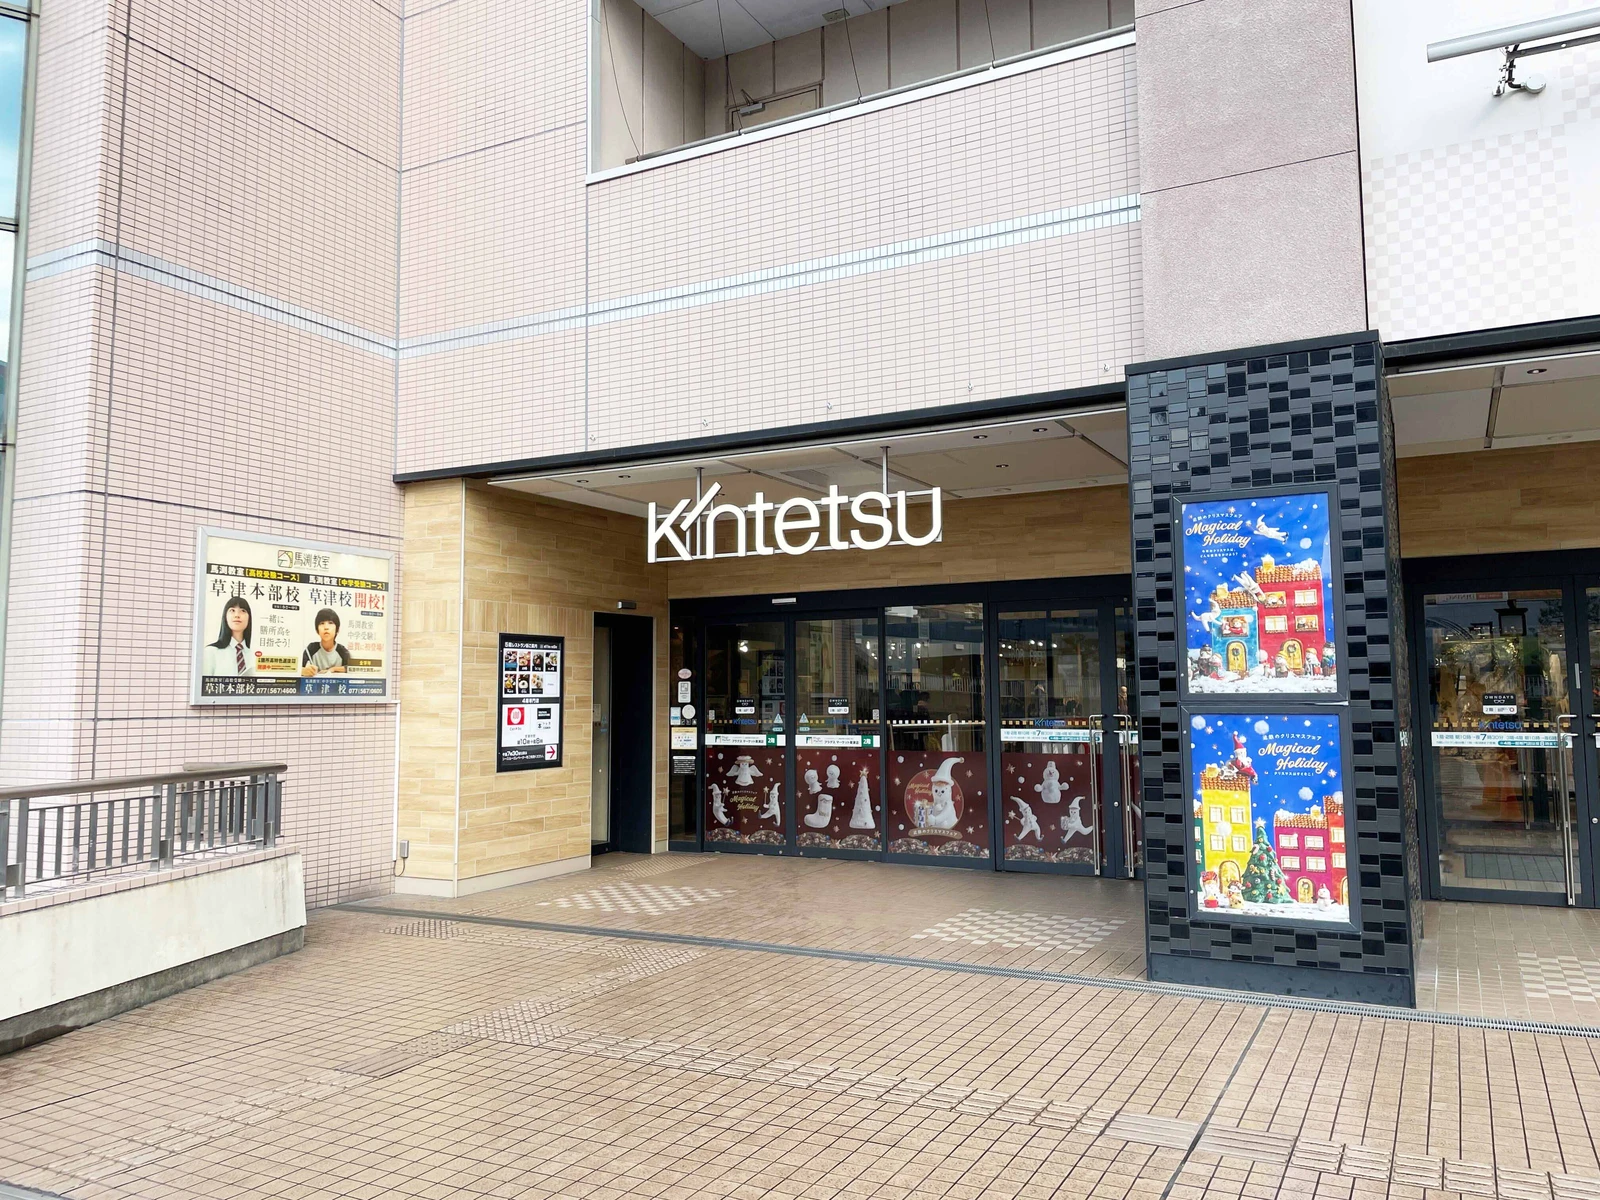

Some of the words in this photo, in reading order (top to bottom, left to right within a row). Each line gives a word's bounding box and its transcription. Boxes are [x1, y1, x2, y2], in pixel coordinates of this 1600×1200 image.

[648, 482, 942, 564] Kintetsu
[1185, 521, 1243, 536] Magical
[1202, 533, 1251, 549] Holiday
[210, 579, 299, 603] 草津本部校
[260, 614, 284, 624] 一緒に
[259, 638, 291, 648] 目指そう!
[205, 683, 255, 694] 草津本部校
[256, 687, 297, 695] 077(567)4600
[1262, 733, 1322, 741] 近鉄のクリスマスフェア
[1258, 742, 1320, 756] Magical
[1275, 757, 1328, 774] Holiday
[729, 795, 757, 803] Magical
[736, 803, 760, 813] Holiday
